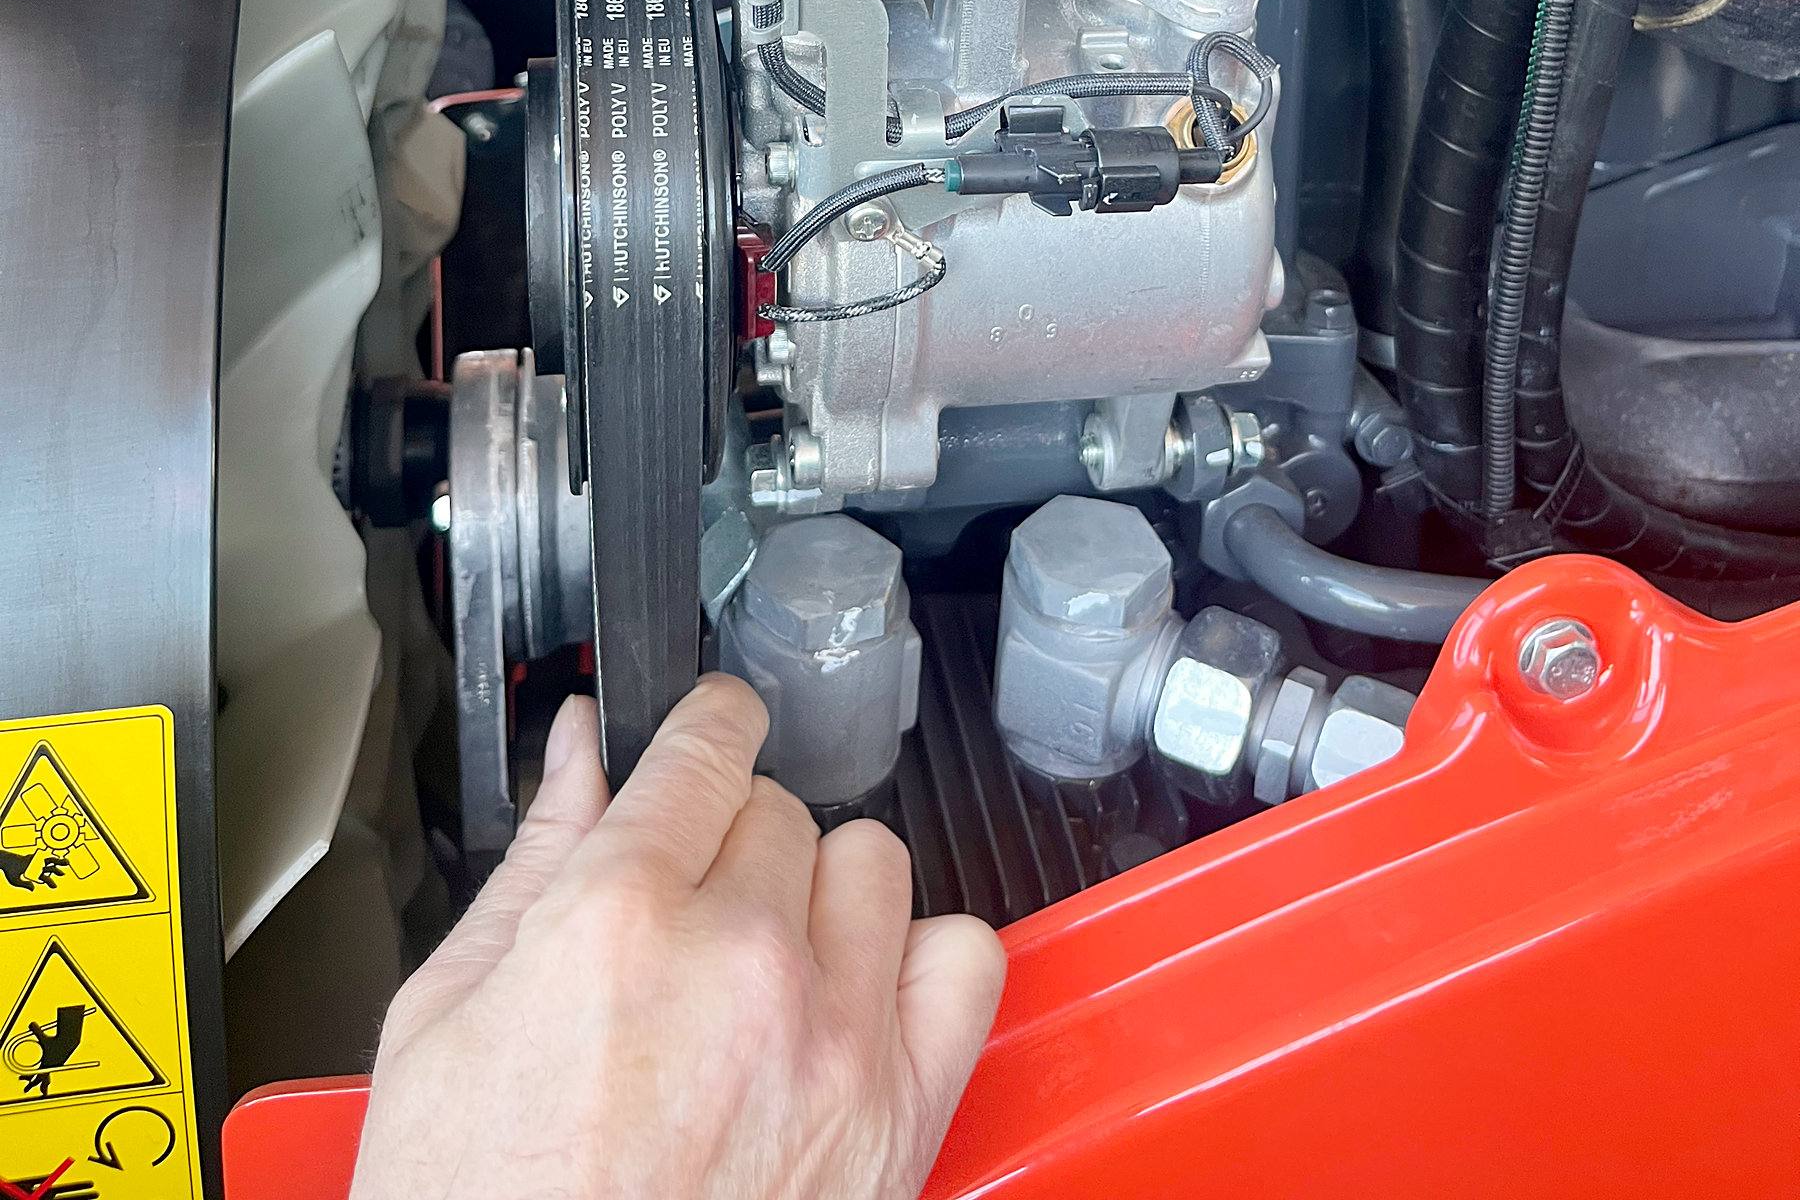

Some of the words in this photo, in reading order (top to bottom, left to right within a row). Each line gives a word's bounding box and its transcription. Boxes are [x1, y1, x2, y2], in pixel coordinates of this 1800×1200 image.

[582, 38, 592, 53] EU
[618, 39, 629, 54] EU
[658, 38, 671, 53] EU
[583, 54, 593, 67] IN
[603, 37, 615, 70] MADE
[642, 37, 654, 70] MADE
[658, 54, 672, 67] IN
[618, 56, 630, 68] IN
[611, 82, 627, 95] V
[650, 82, 668, 94] V
[611, 97, 628, 139] POLY
[651, 97, 669, 138] POLY
